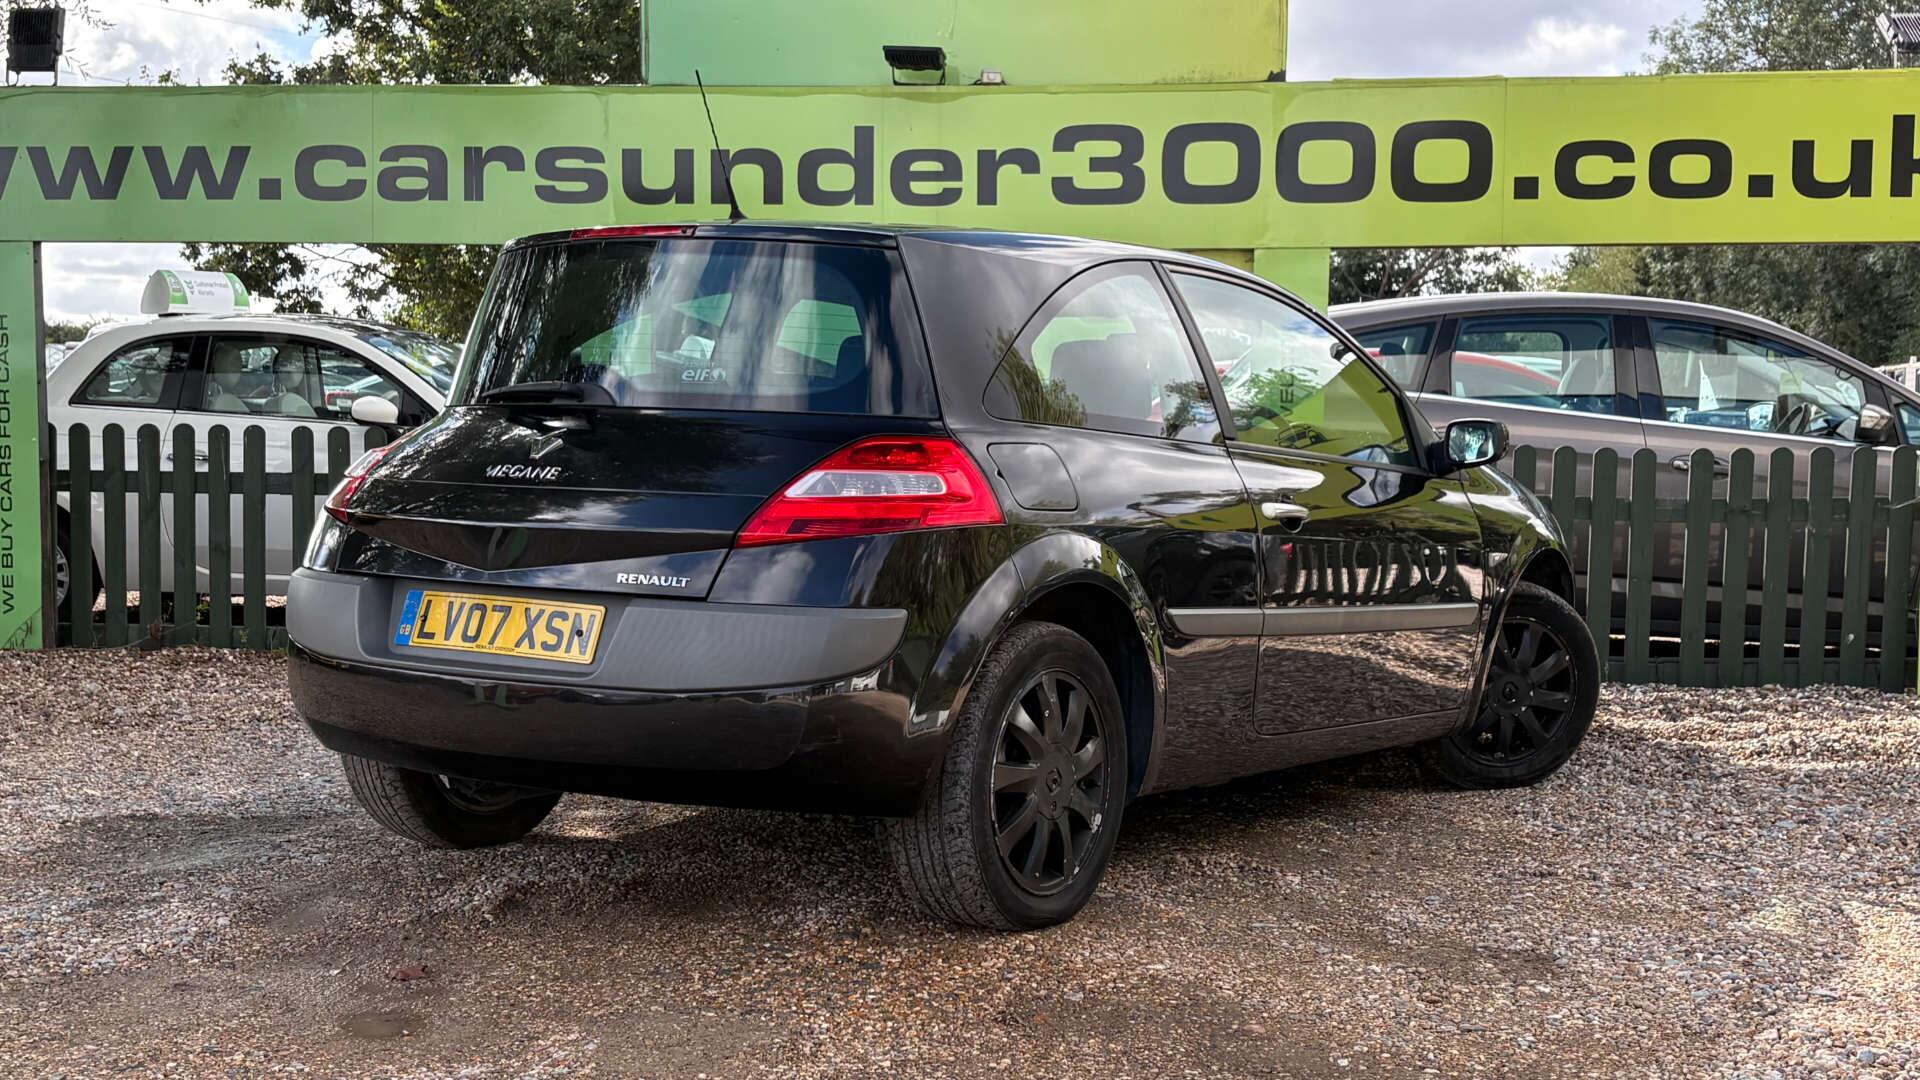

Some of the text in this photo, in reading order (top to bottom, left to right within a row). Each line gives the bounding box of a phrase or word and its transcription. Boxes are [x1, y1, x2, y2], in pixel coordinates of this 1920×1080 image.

[0, 114, 1920, 206] ww.carsunder3000.co.u
[0, 314, 15, 614] WE BUY CARS FOR CASH
[616, 572, 691, 588] RENAULT
[416, 599, 596, 656] LV07 XSN
